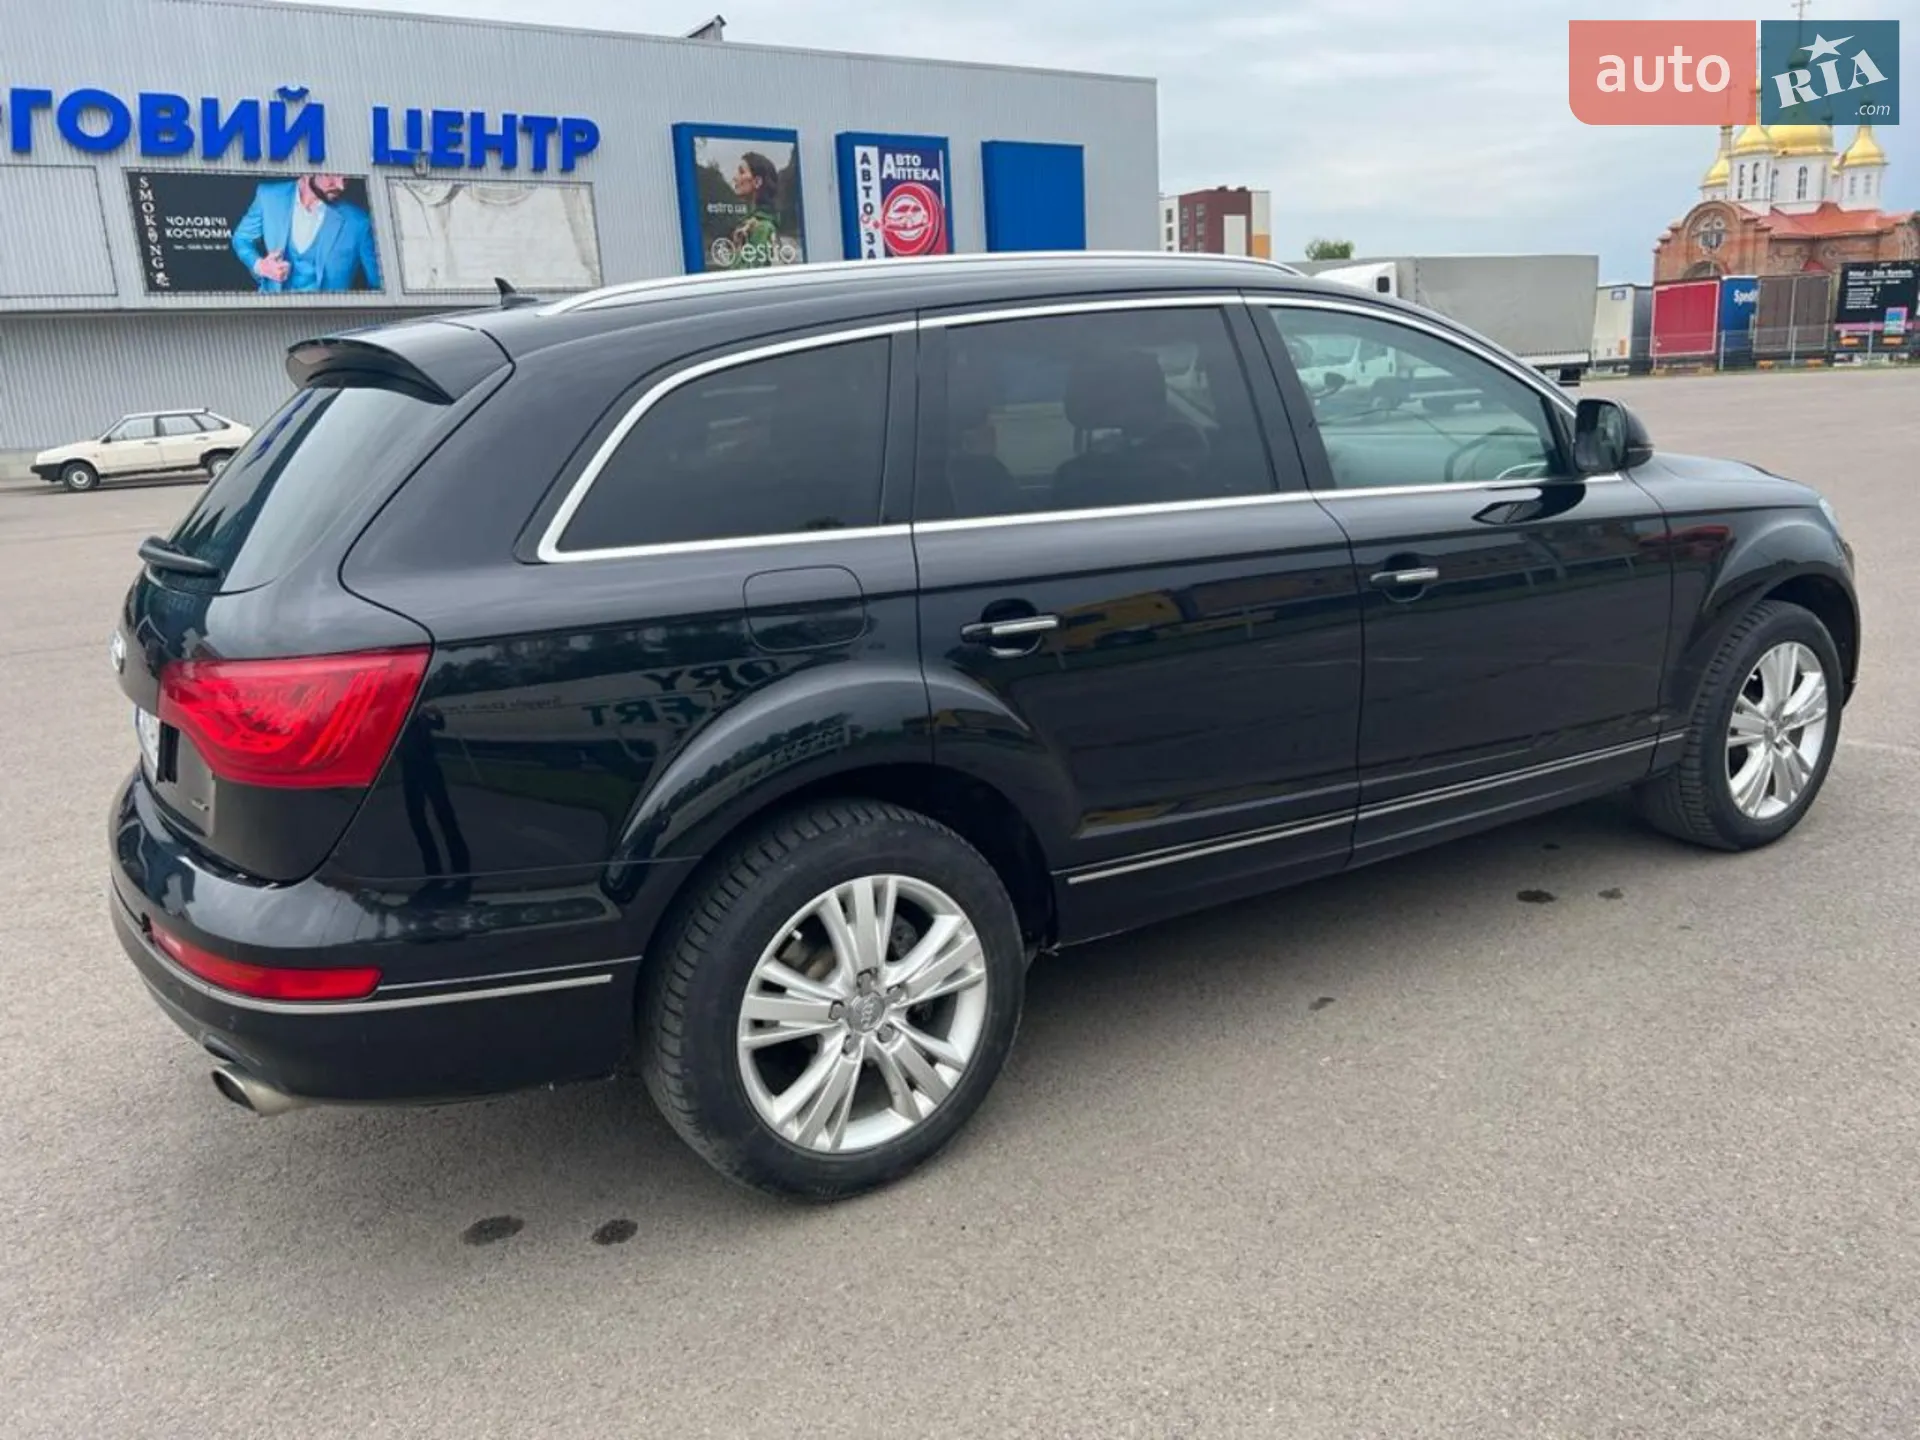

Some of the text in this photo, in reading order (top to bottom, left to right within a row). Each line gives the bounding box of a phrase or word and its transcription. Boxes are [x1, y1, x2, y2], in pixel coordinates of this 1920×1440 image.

[0, 86, 600, 174] ГОВИЙ ЦЕНТР
[165, 227, 232, 239] КОСТЮМИ
[742, 242, 796, 264] estro
